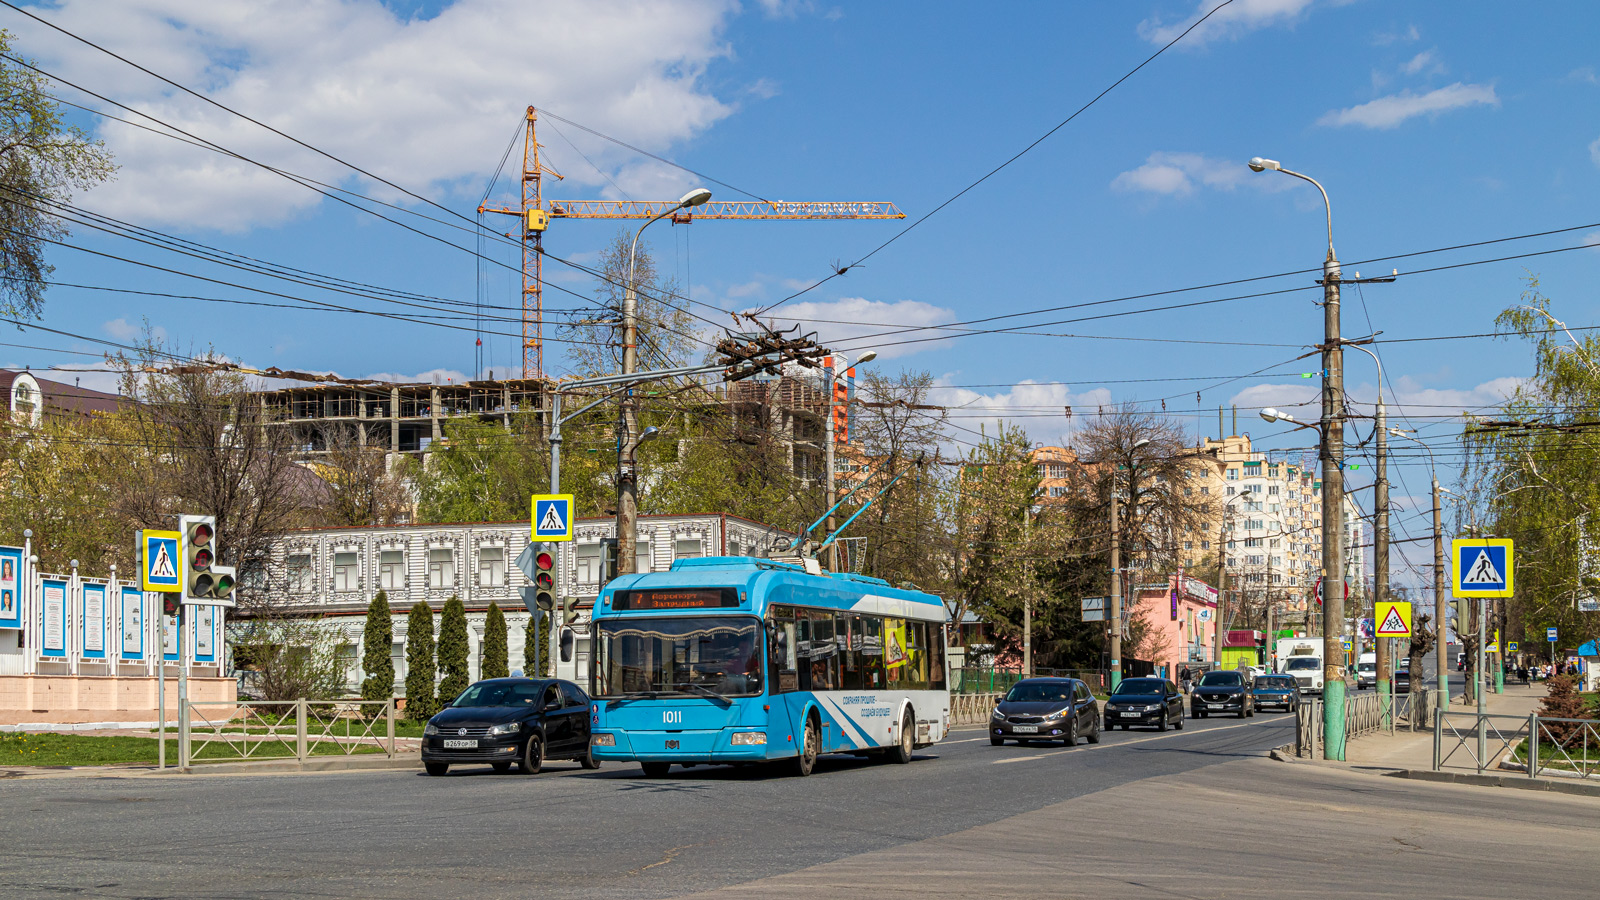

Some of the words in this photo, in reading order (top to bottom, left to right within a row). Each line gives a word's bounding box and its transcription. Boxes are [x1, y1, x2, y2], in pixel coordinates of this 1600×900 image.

[539, 575, 553, 588] 14
[636, 593, 643, 604] 7
[663, 711, 682, 723] 1011
